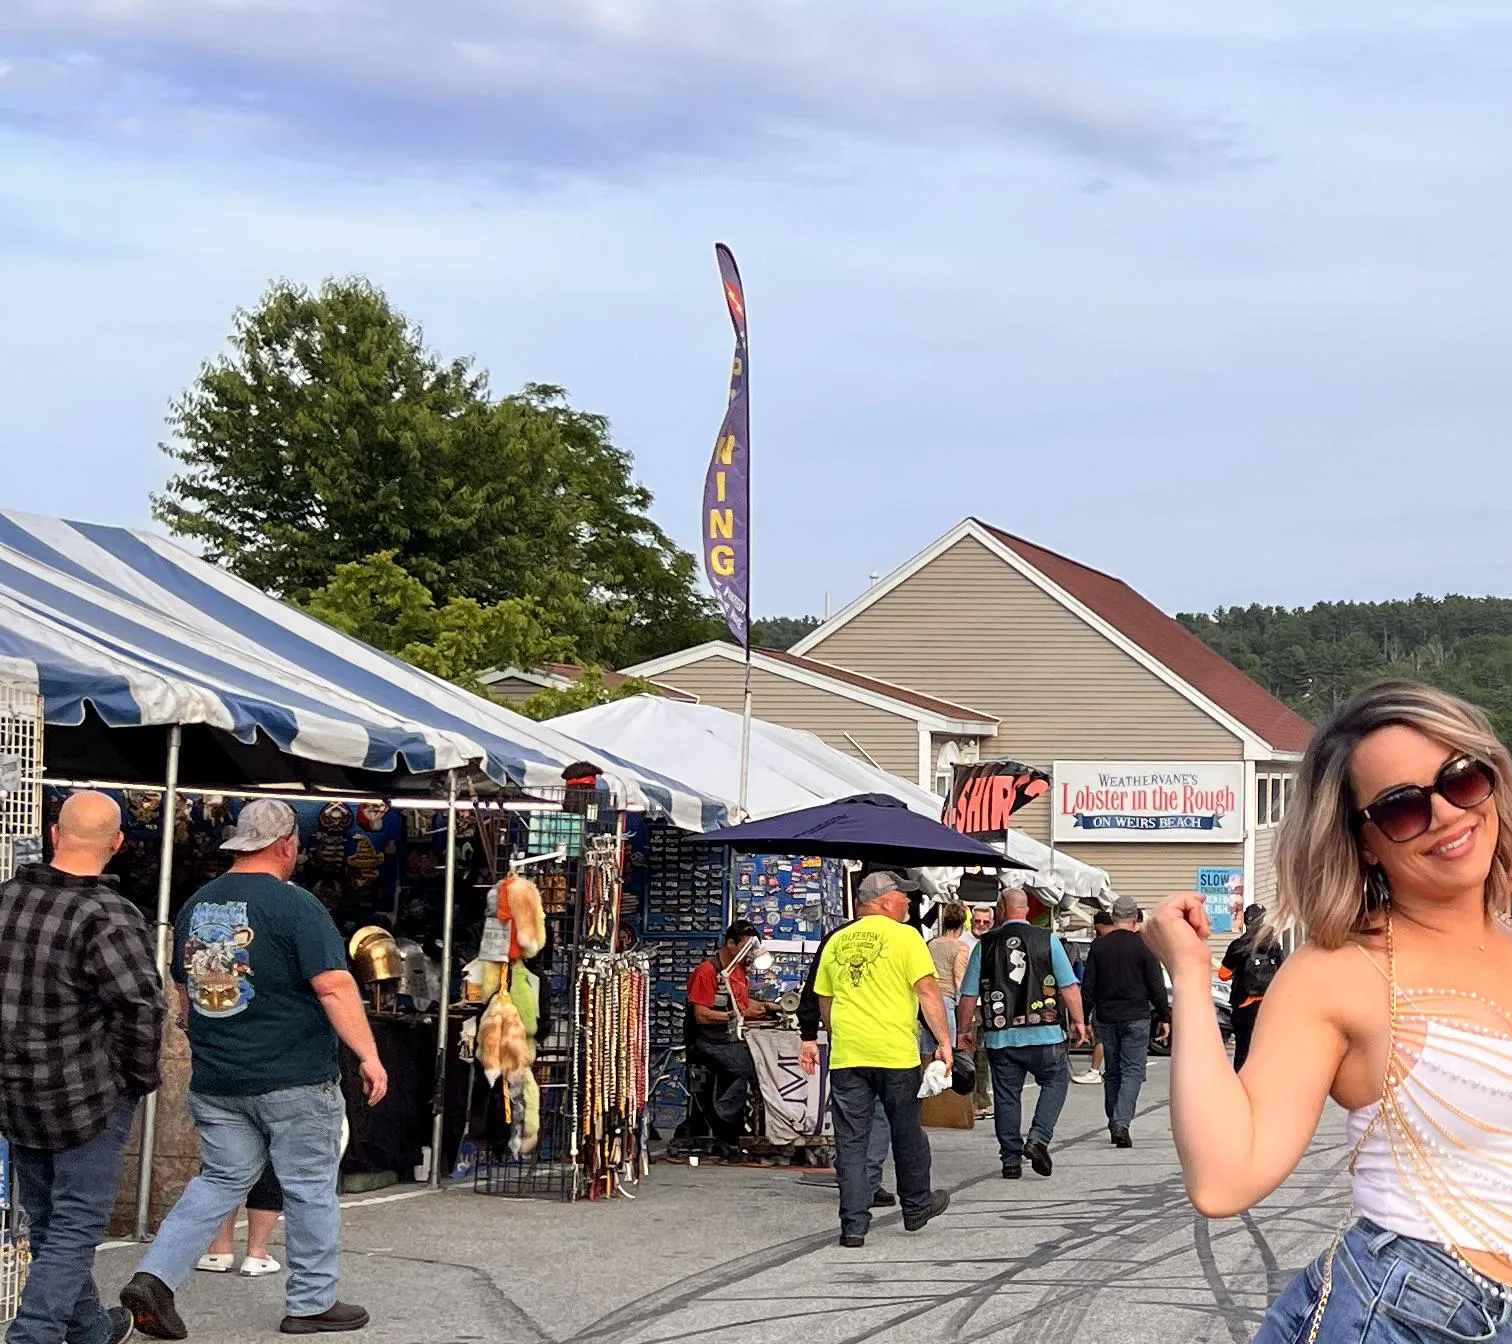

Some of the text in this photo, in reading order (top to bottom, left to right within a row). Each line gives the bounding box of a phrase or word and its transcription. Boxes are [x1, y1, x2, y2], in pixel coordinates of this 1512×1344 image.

[1098, 773, 1199, 788] WEATHERVANE'S
[1061, 783, 1236, 816] Lobster in the Rough
[1093, 817, 1202, 829] ON WEIRS BEACH
[1200, 874, 1229, 886] SLOW
